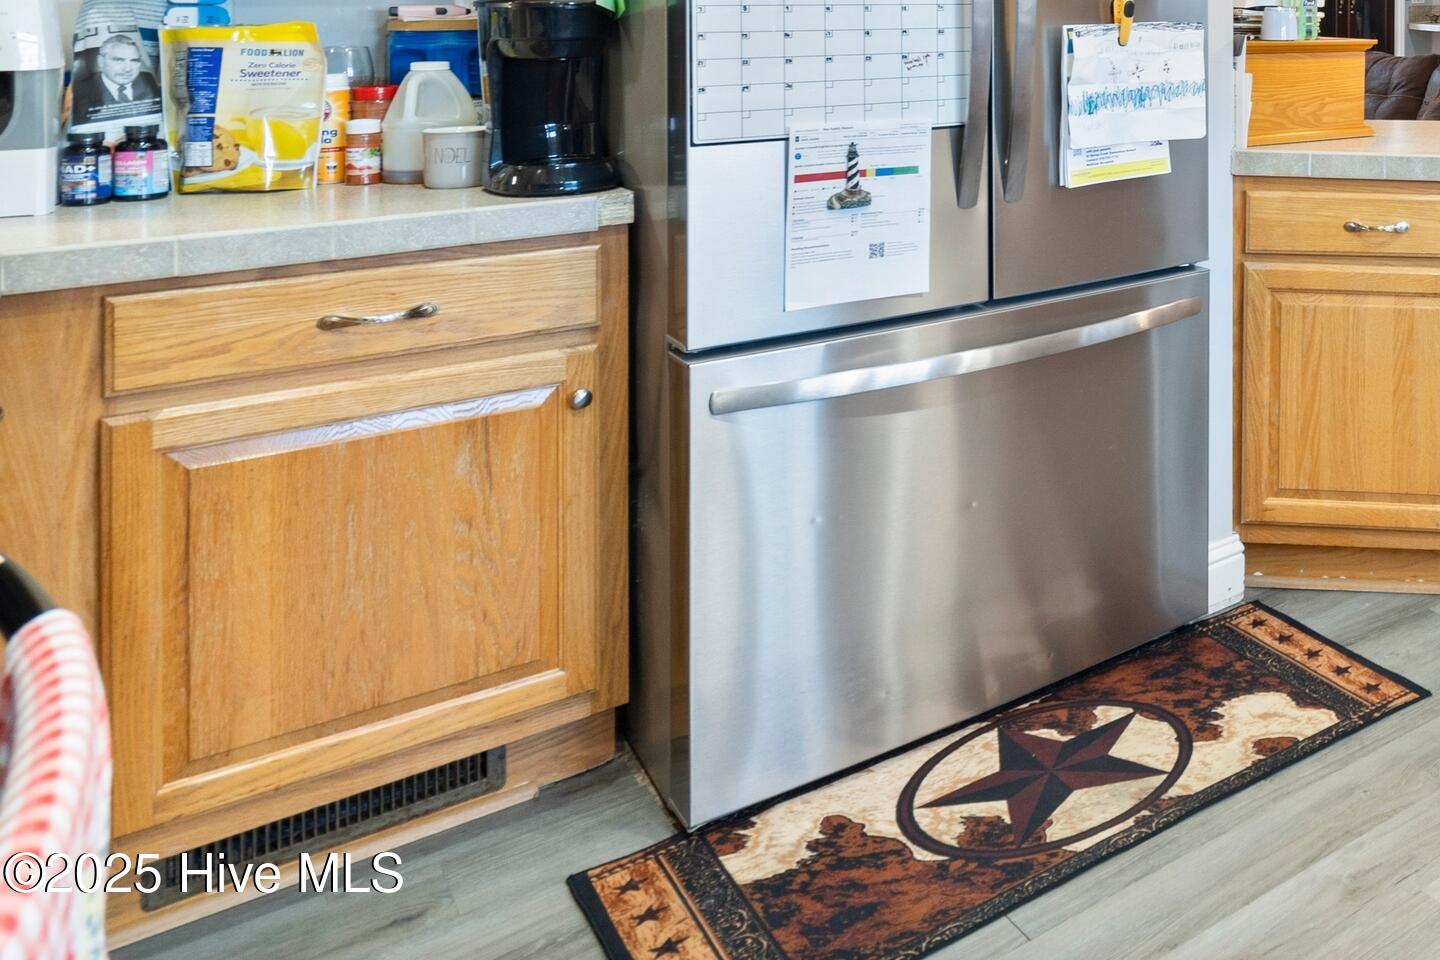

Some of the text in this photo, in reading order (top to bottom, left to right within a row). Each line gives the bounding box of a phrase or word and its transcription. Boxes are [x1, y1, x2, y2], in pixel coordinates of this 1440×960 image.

[240, 48, 305, 57] FOOD LION
[268, 61, 296, 69] Calorie
[239, 69, 303, 78] Sweetener
[433, 147, 471, 165] NOEL
